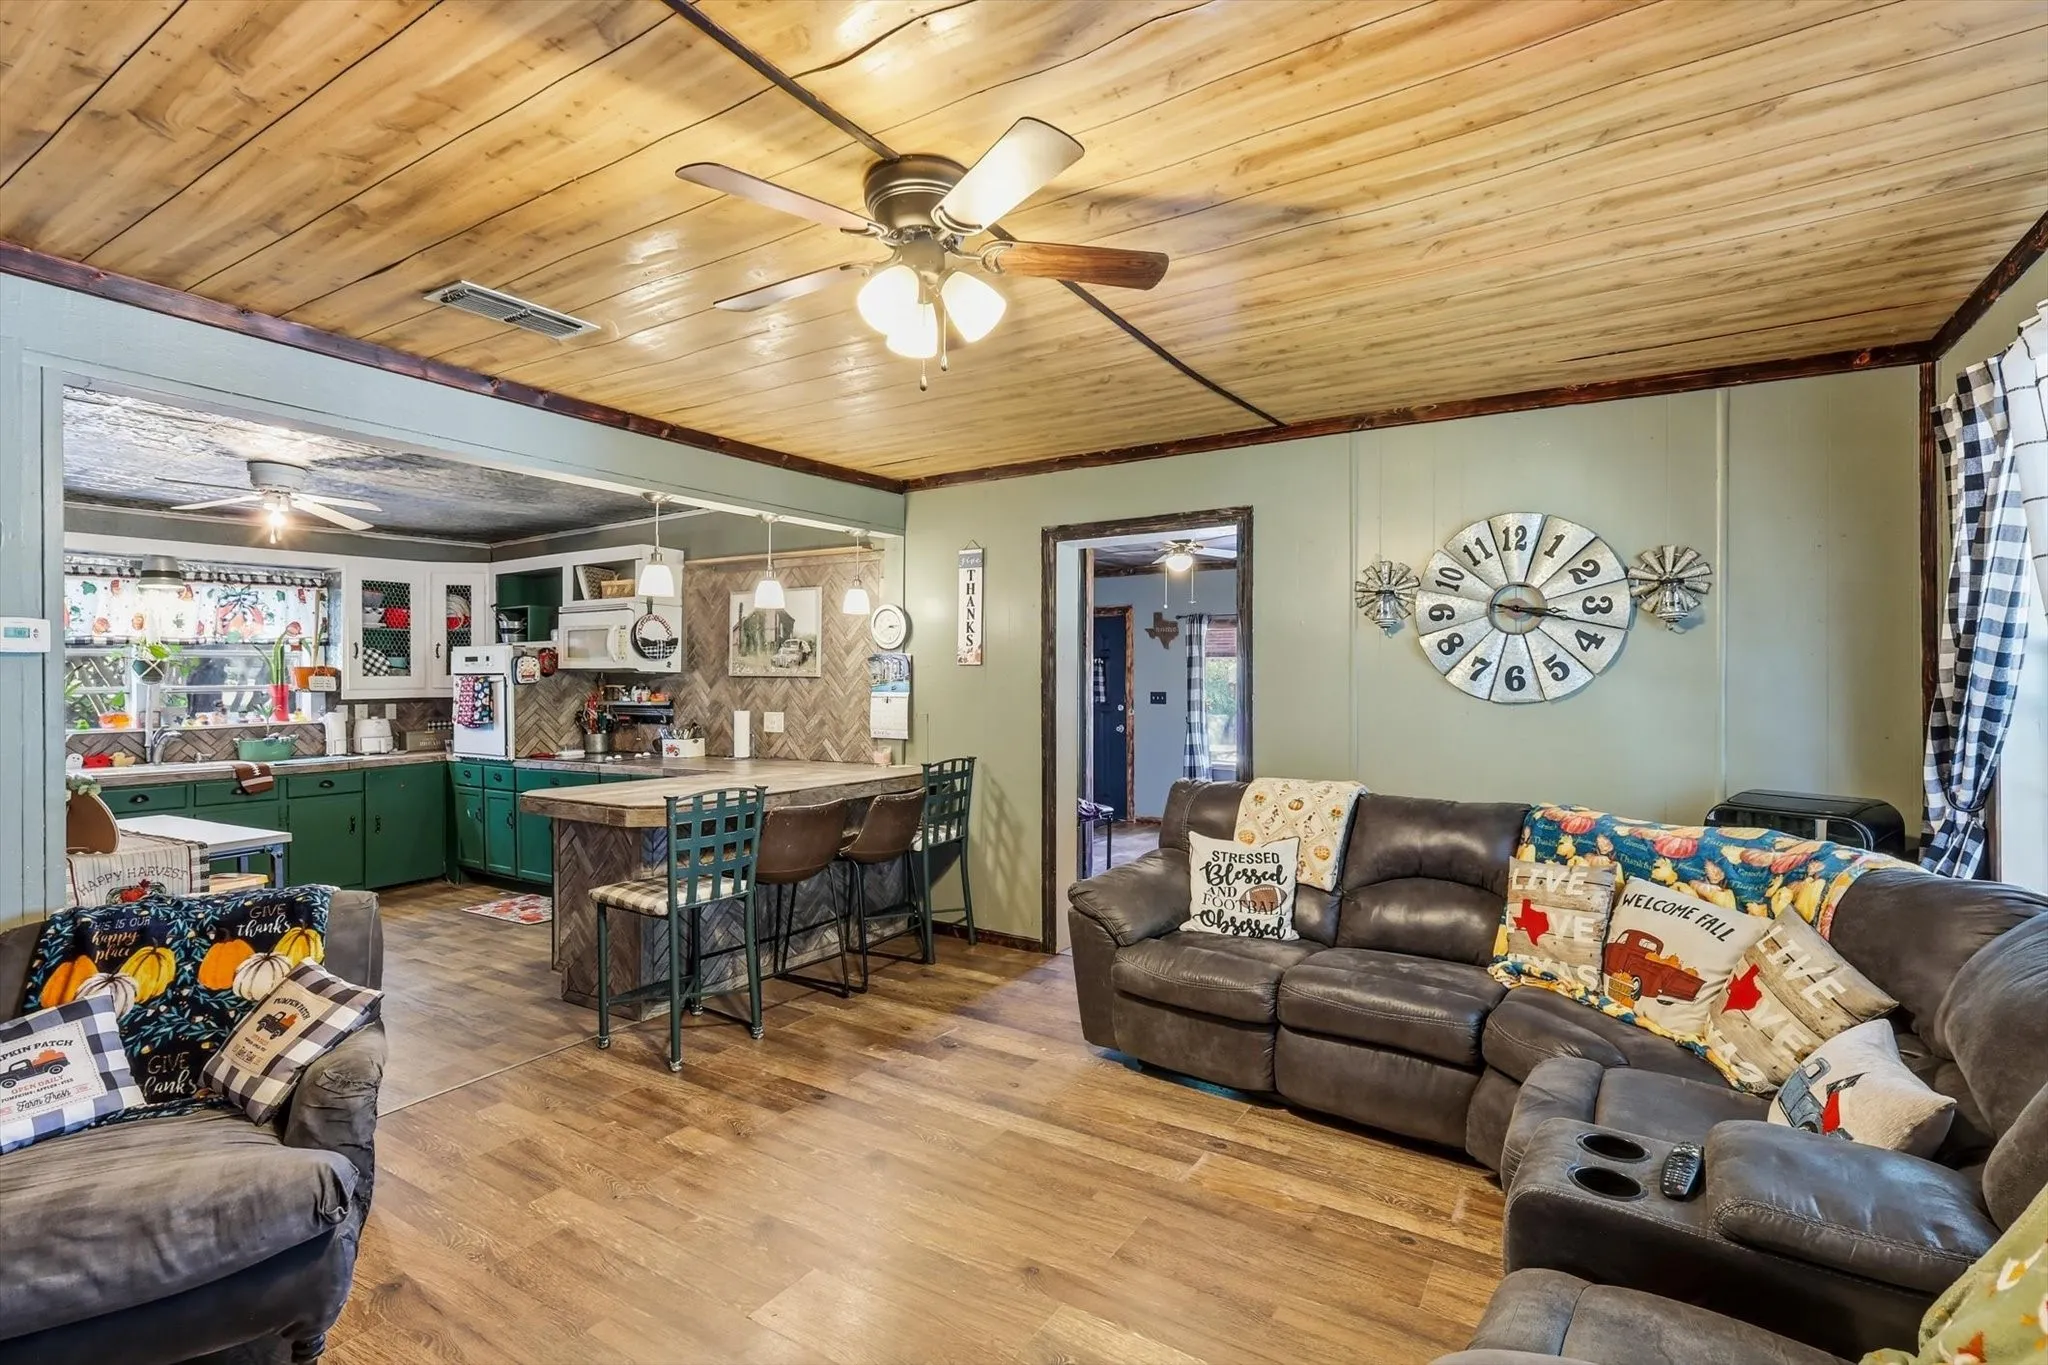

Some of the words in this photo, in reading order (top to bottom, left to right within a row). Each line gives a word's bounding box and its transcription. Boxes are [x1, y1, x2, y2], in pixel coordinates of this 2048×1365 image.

[1502, 525, 1527, 551] 12
[1544, 533, 1566, 559] 1
[1462, 537, 1494, 567] 11
[1435, 566, 1465, 592] 10
[1568, 559, 1601, 585] 2
[966, 569, 976, 646] THANKS
[1428, 604, 1455, 622] 9
[1581, 595, 1613, 615] 3
[1437, 632, 1464, 655] 8
[1574, 629, 1606, 652] 4
[1469, 656, 1493, 682] 7
[1504, 665, 1526, 691] 6
[1542, 654, 1570, 681] 5
[1211, 850, 1280, 864] STRESSED
[77, 870, 122, 896] HAPPY
[127, 867, 188, 880] HARVEST
[1200, 861, 1287, 886] Blessed
[1511, 867, 1588, 896] LIVE
[1206, 886, 1238, 898] AND
[250, 903, 286, 919] GIVE
[1202, 893, 1287, 917] FOOTBALL
[1622, 893, 1700, 920] WELCOME
[1695, 914, 1735, 942] FALL
[116, 918, 125, 929] IS
[129, 917, 151, 927] OUR
[237, 914, 291, 937] thanks
[1192, 908, 1287, 939] Obsessed
[91, 931, 137, 947] happy
[1756, 924, 1846, 1009] LIVE
[34, 1039, 73, 1050] PATCH
[147, 1051, 190, 1074] GIVE
[11, 1083, 37, 1094] OPEN
[38, 1074, 63, 1087] DAILY
[143, 1069, 198, 1097] hanks
[17, 1099, 42, 1112] Farm
